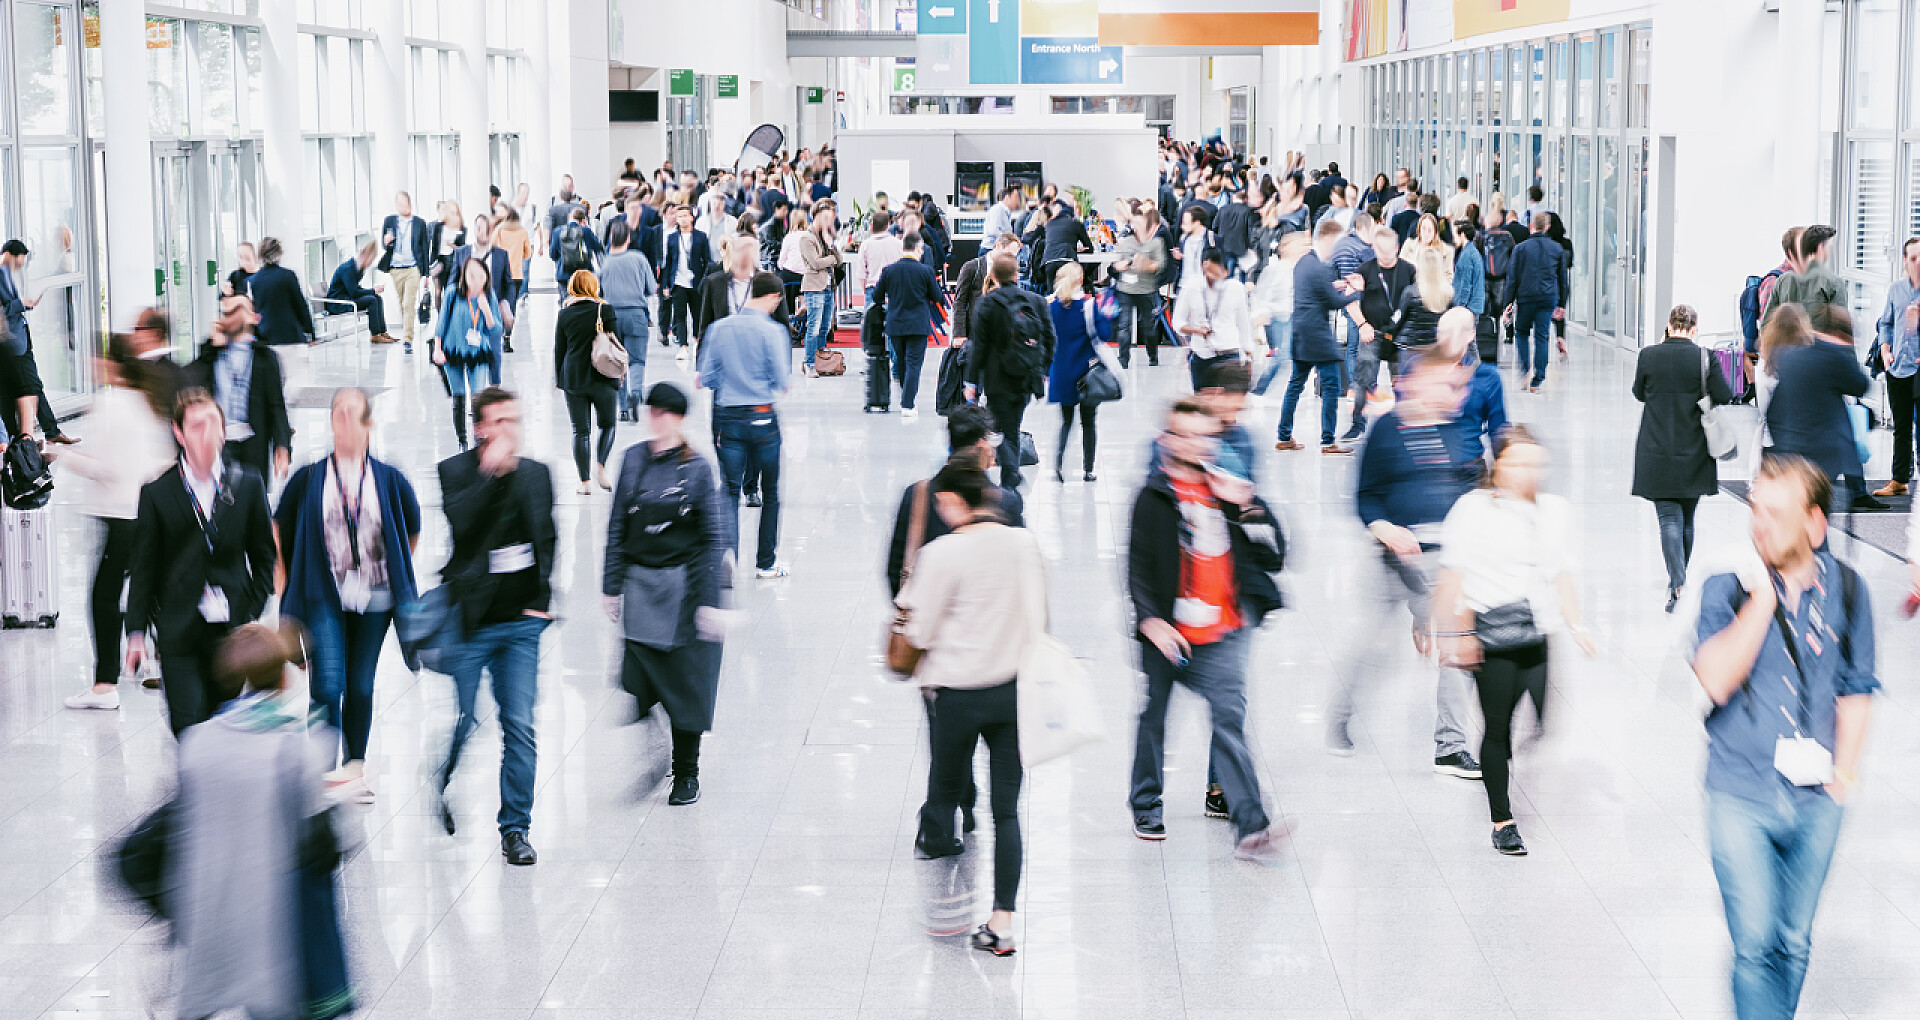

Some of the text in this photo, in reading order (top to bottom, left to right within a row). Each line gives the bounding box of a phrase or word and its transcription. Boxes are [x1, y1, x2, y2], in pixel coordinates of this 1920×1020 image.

[1031, 43, 1101, 54] Entrance North
[902, 73, 914, 91] 8
